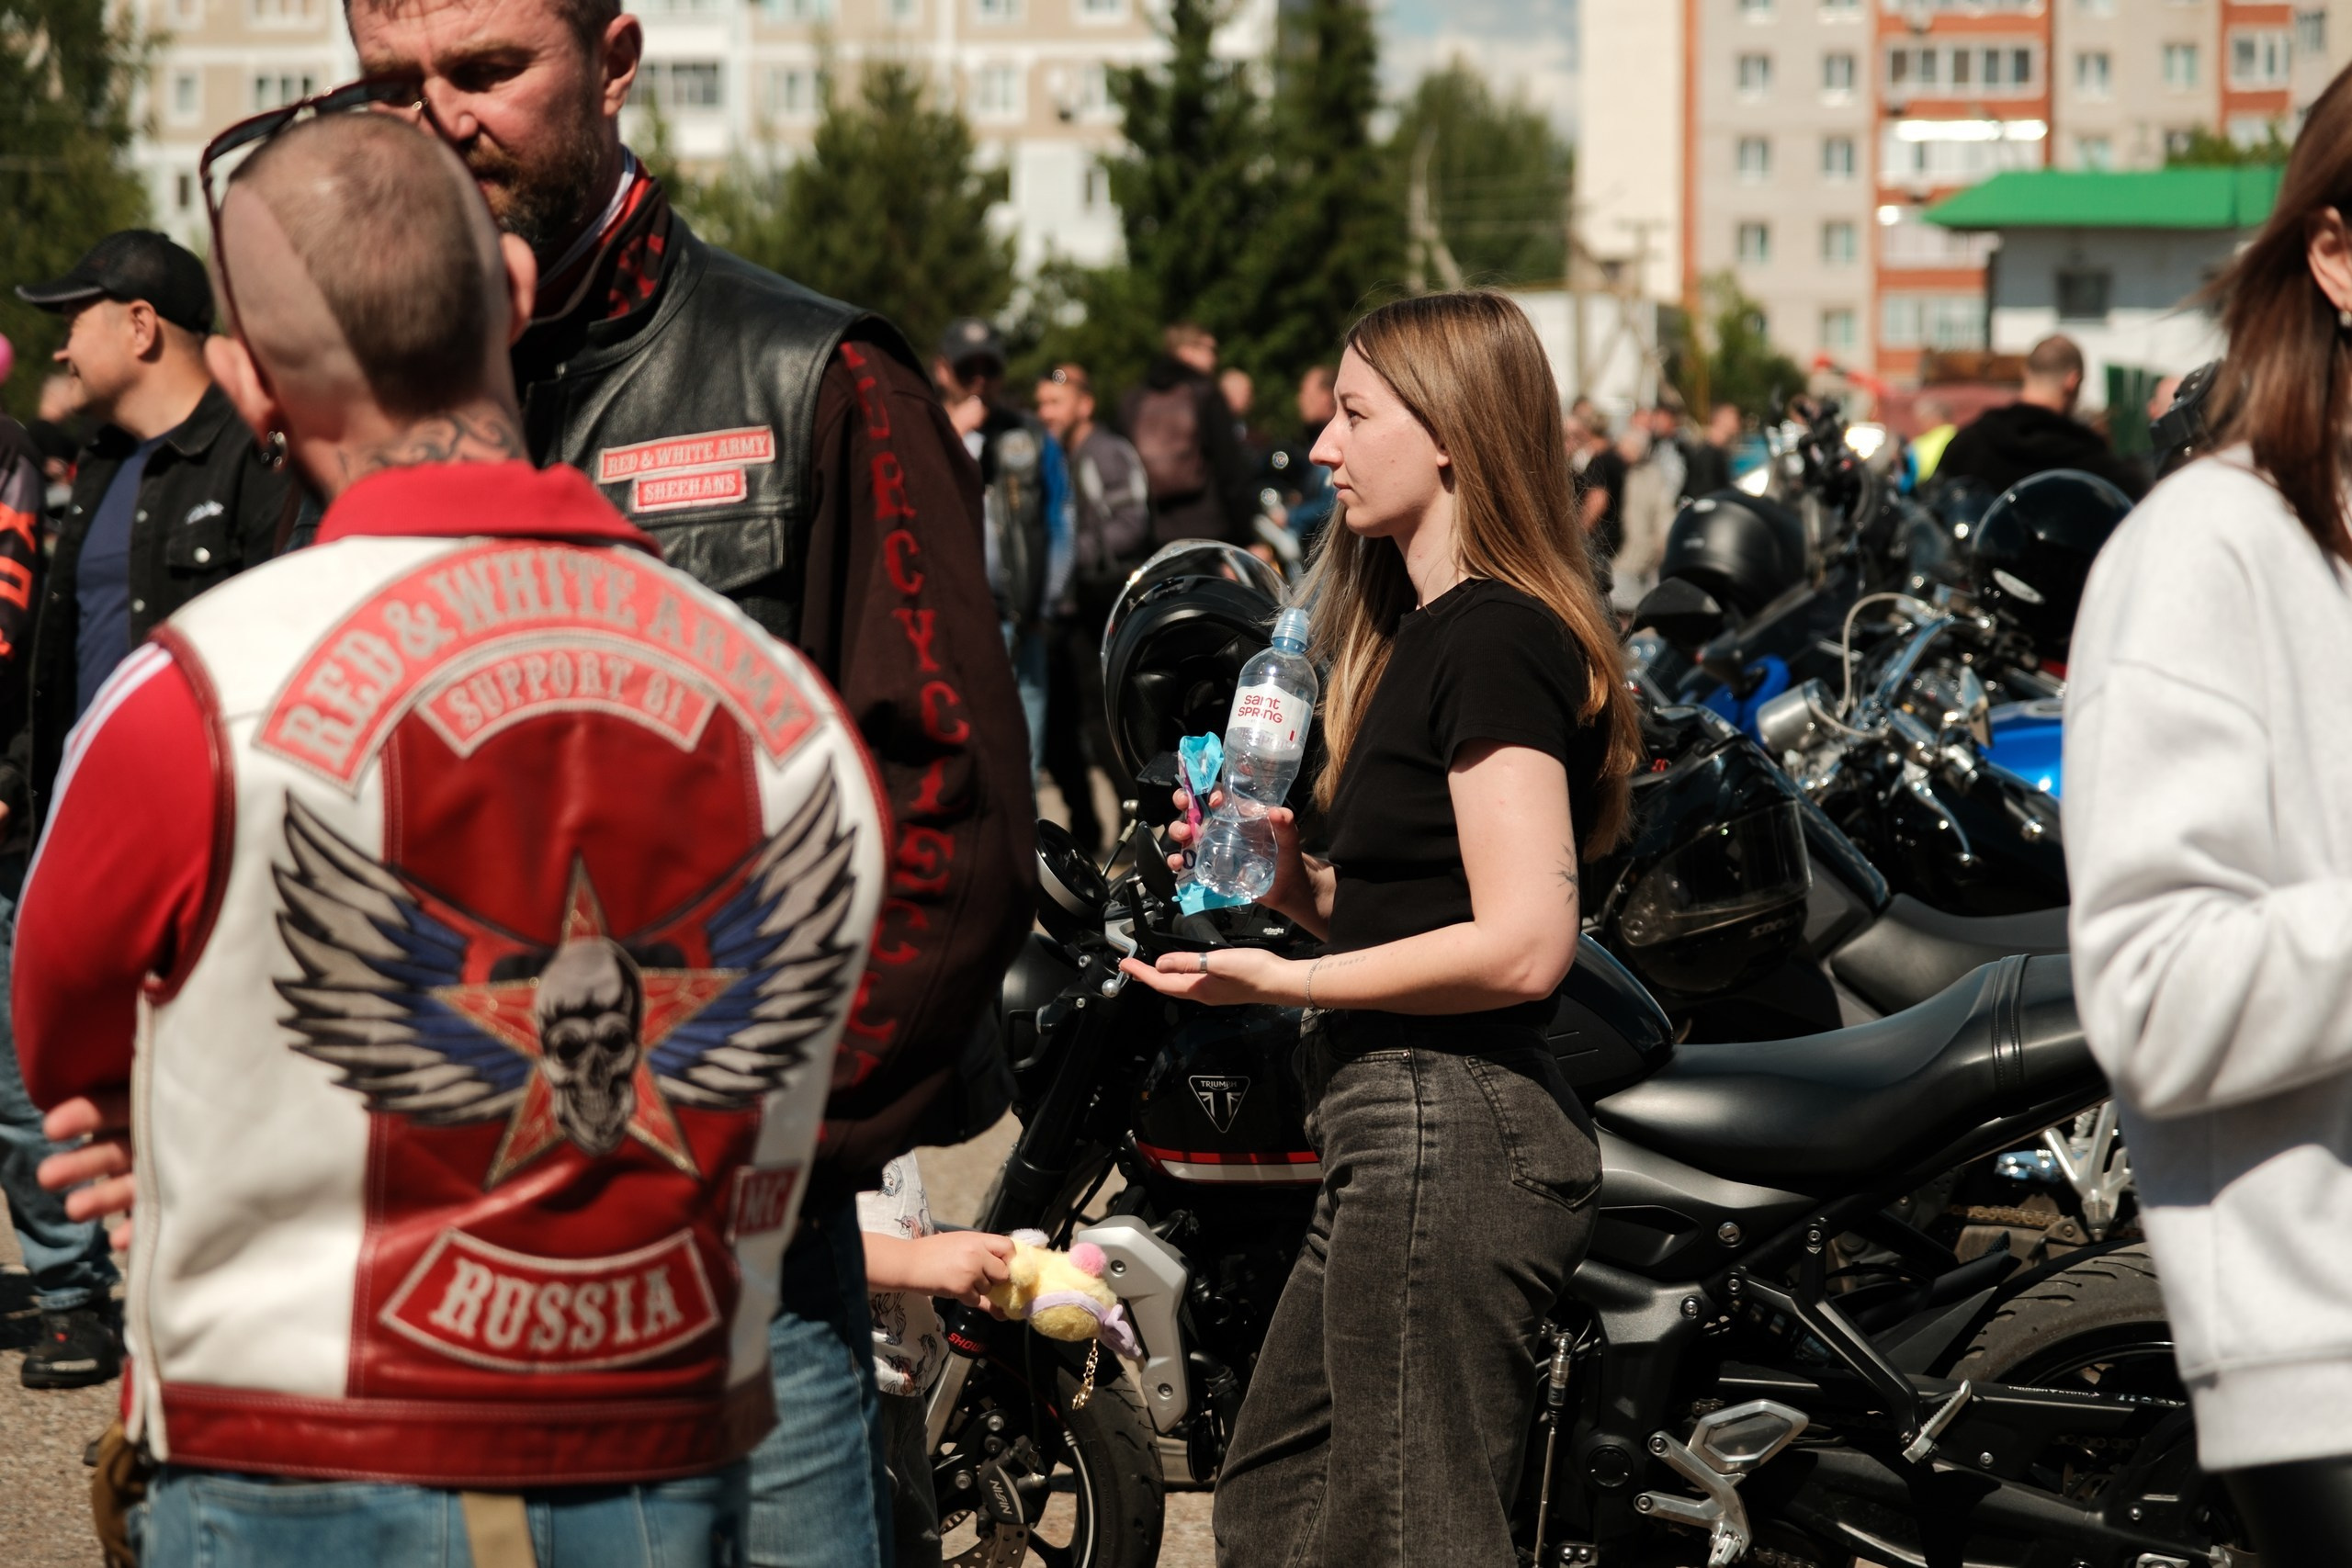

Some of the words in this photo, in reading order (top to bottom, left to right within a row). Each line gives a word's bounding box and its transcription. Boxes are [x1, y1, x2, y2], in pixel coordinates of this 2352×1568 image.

[607, 455, 637, 474] RED
[641, 450, 654, 468] &
[656, 441, 714, 466] WHITE
[716, 434, 769, 459] ARMY
[644, 472, 737, 502] SHEEHANS
[278, 627, 390, 770] RED
[382, 599, 458, 659] &
[428, 547, 638, 633] WHITE
[646, 589, 809, 739] ARMY
[447, 650, 632, 731] SUPPORT
[1238, 706, 1283, 723] SPRNG
[1200, 1080, 1237, 1089] TRIUMPH
[428, 1257, 684, 1351] RUSSIA
